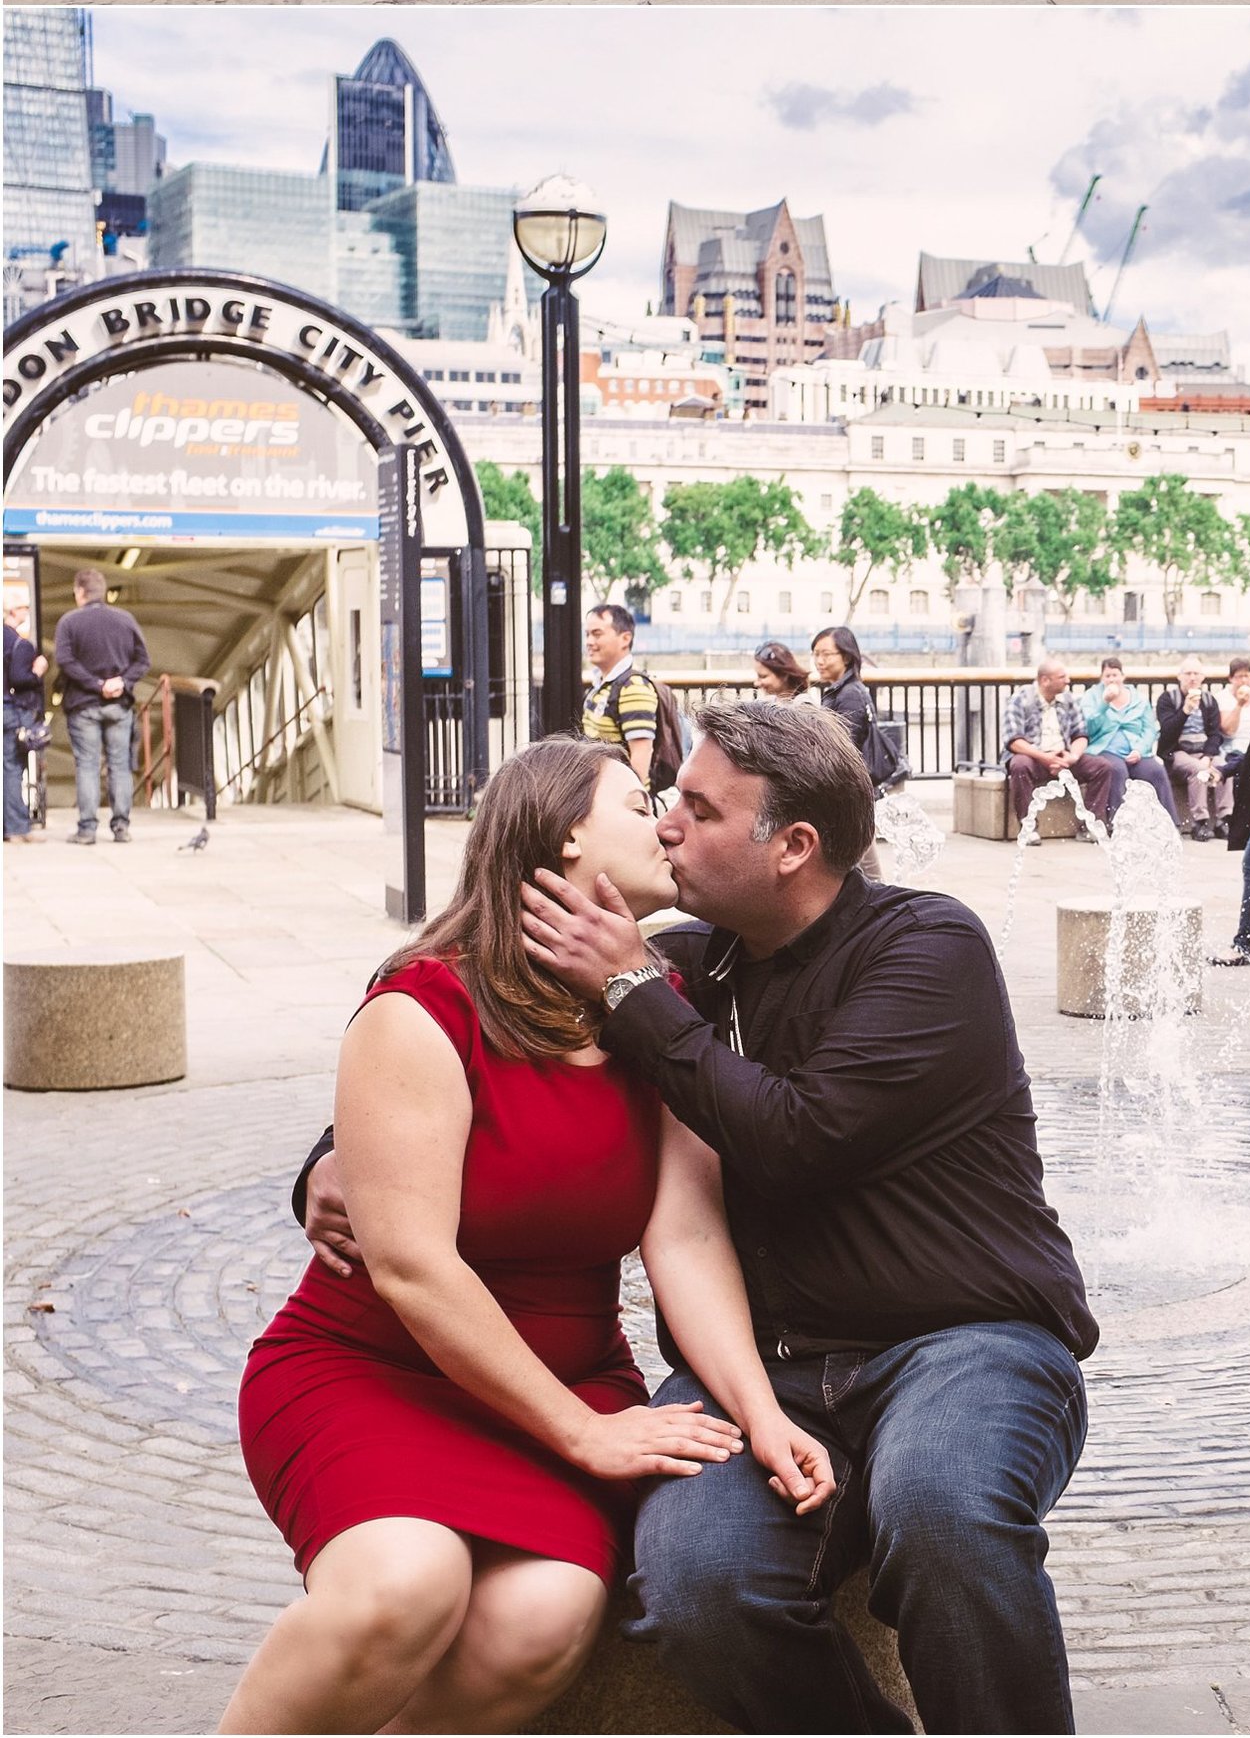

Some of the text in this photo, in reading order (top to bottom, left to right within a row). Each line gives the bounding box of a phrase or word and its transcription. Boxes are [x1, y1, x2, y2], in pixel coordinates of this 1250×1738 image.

[101, 298, 273, 335] BRIDGE
[299, 325, 386, 386] CITY
[388, 399, 449, 495] PIER
[133, 390, 299, 422] thames
[85, 407, 299, 448] clippers
[30, 466, 367, 500] The fastest fleet on the river.
[36, 511, 173, 531] thamesclippers.com
